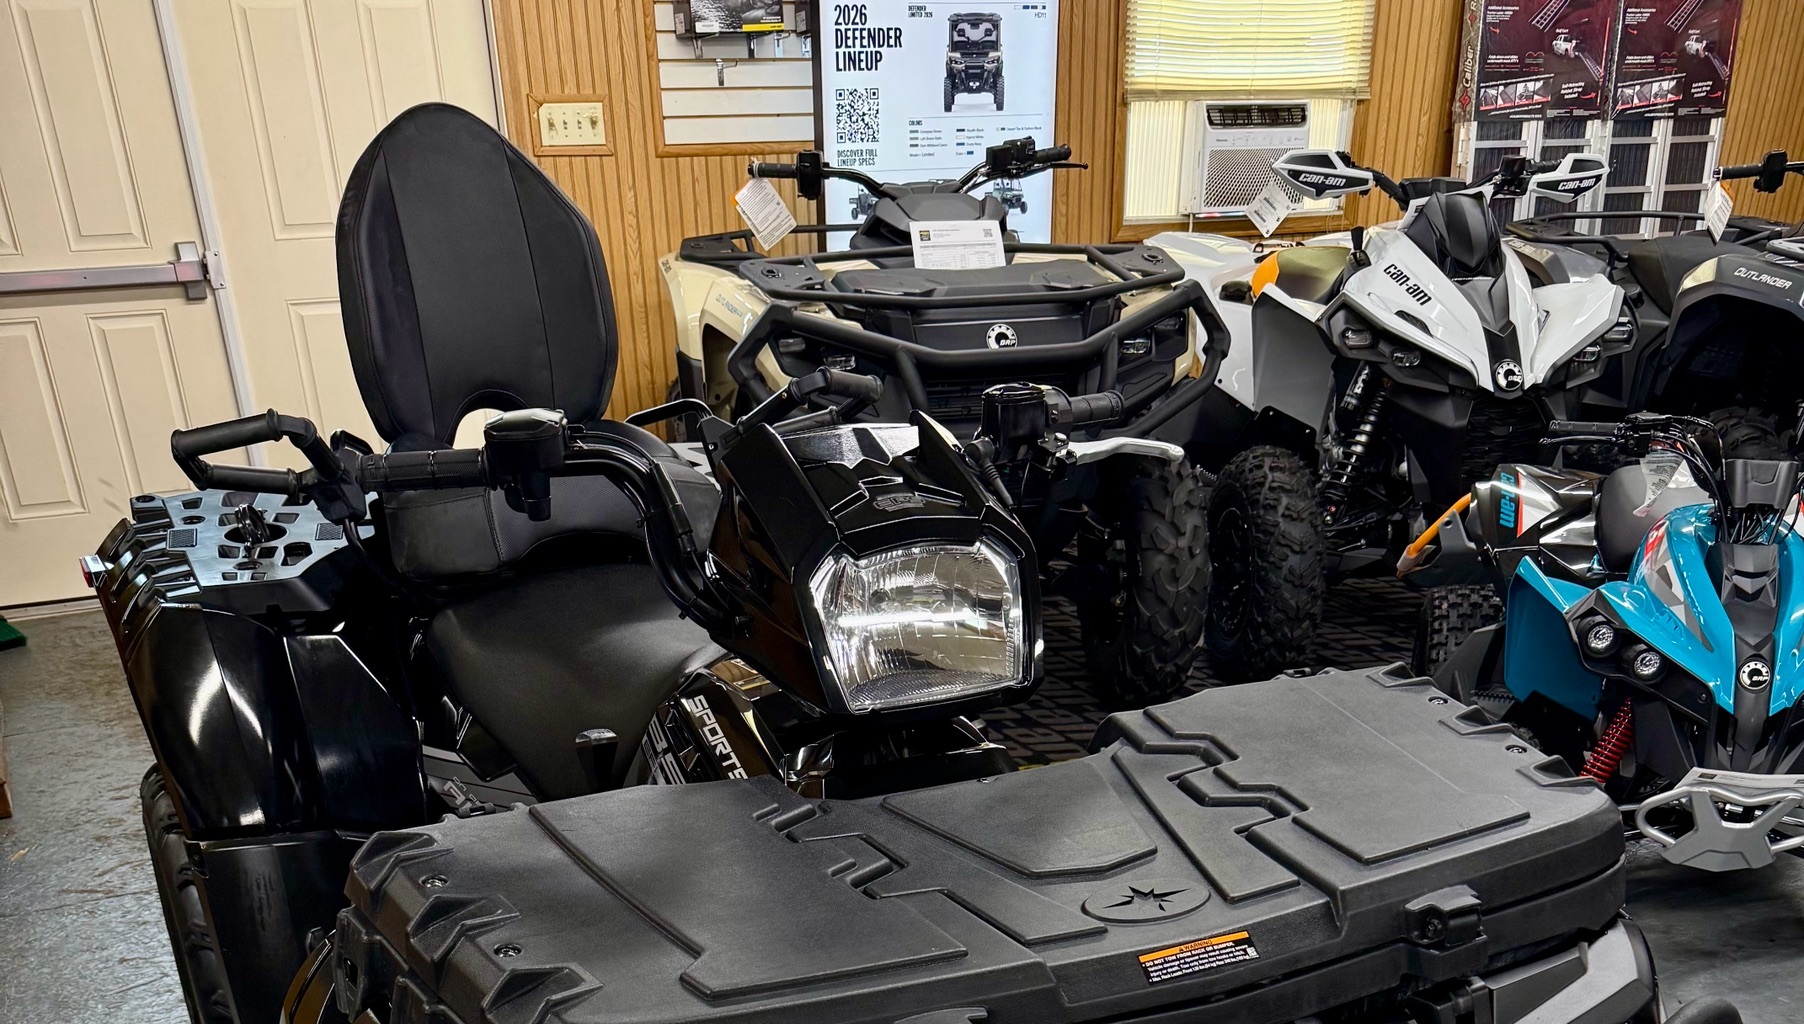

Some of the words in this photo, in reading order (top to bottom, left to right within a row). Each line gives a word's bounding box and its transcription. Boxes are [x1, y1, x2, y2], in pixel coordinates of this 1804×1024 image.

[834, 4, 867, 26] 2026
[835, 27, 903, 49] DEFENDER
[836, 50, 883, 72] LINEUP
[1463, 45, 1474, 88] Caliber
[837, 149, 864, 158] DISCOVER
[865, 149, 878, 157] FULL
[838, 158, 856, 167] LINEUP
[858, 157, 876, 166] SPECS
[1299, 173, 1347, 187] can-am
[1558, 178, 1596, 190] can-am
[1383, 263, 1432, 306] can-am
[1734, 267, 1793, 289] OUTLANDER
[1184, 940, 1212, 950] WARNING
